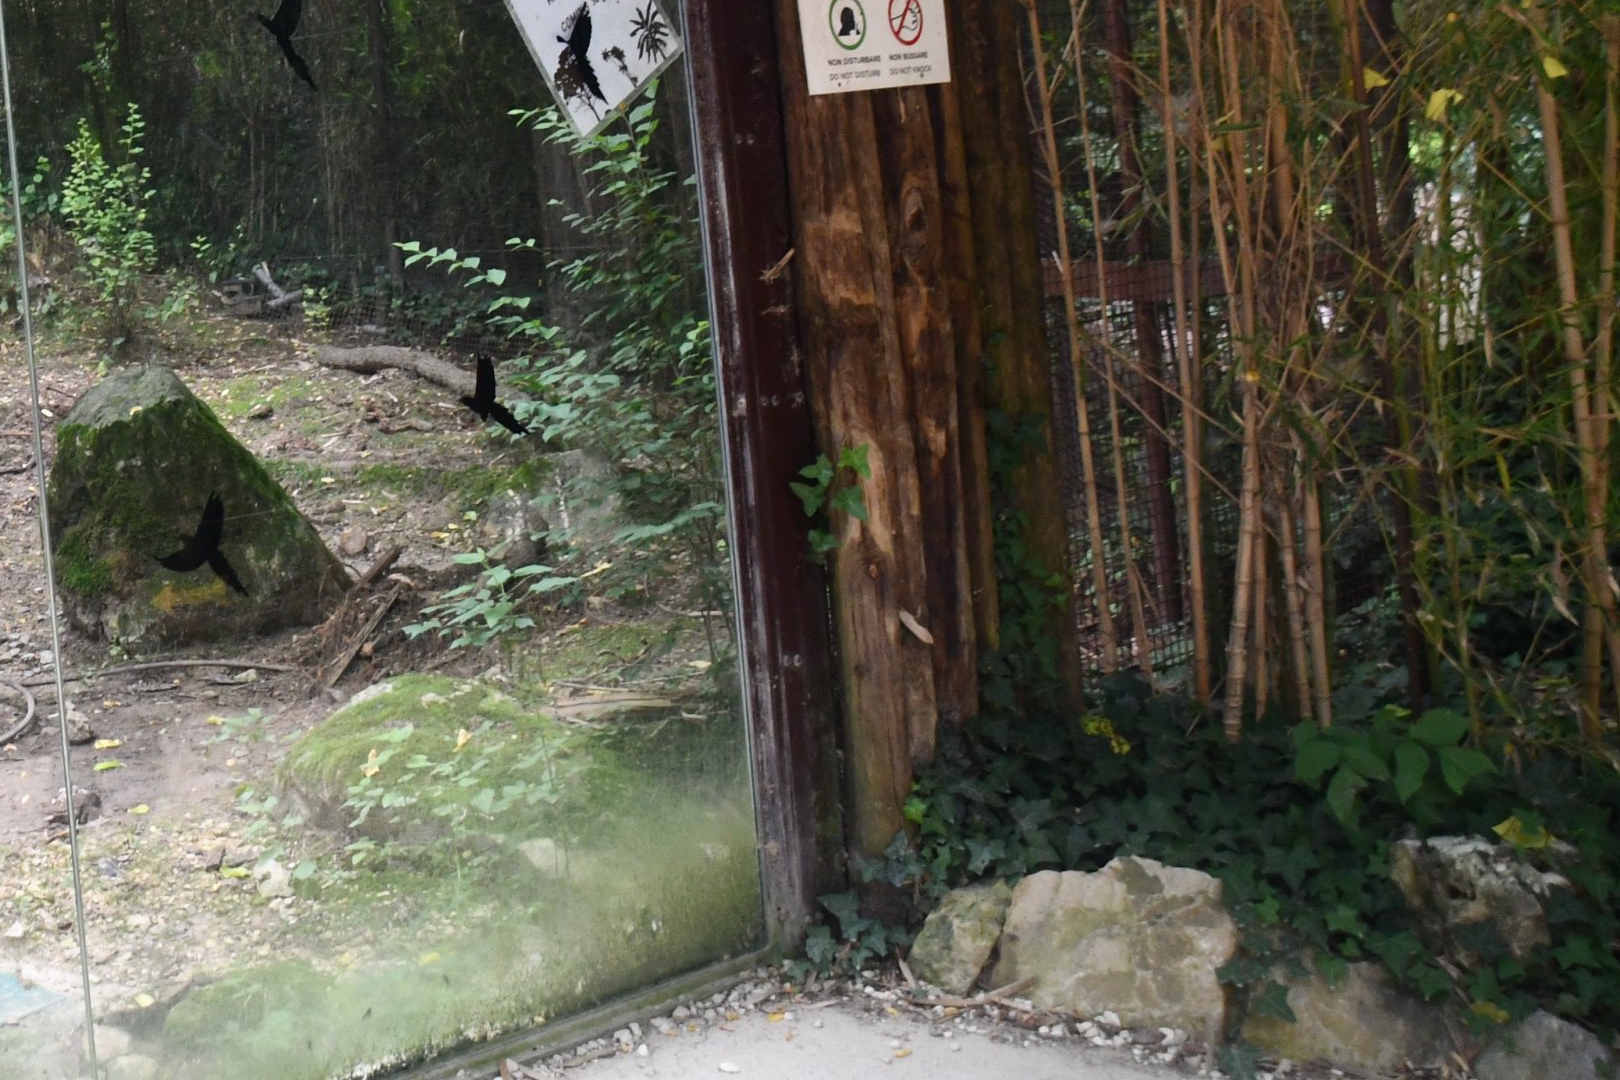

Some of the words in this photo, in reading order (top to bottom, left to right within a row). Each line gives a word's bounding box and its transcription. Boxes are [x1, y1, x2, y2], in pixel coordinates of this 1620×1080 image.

[828, 58, 842, 66] NON
[843, 55, 881, 65] DISTURBARE
[889, 53, 901, 61] NON
[903, 51, 928, 60] BUSSARE
[829, 73, 839, 81] DO
[841, 71, 853, 79] NOT
[855, 69, 881, 78] DISTURB
[890, 68, 899, 76] DO
[900, 66, 911, 75] NOT
